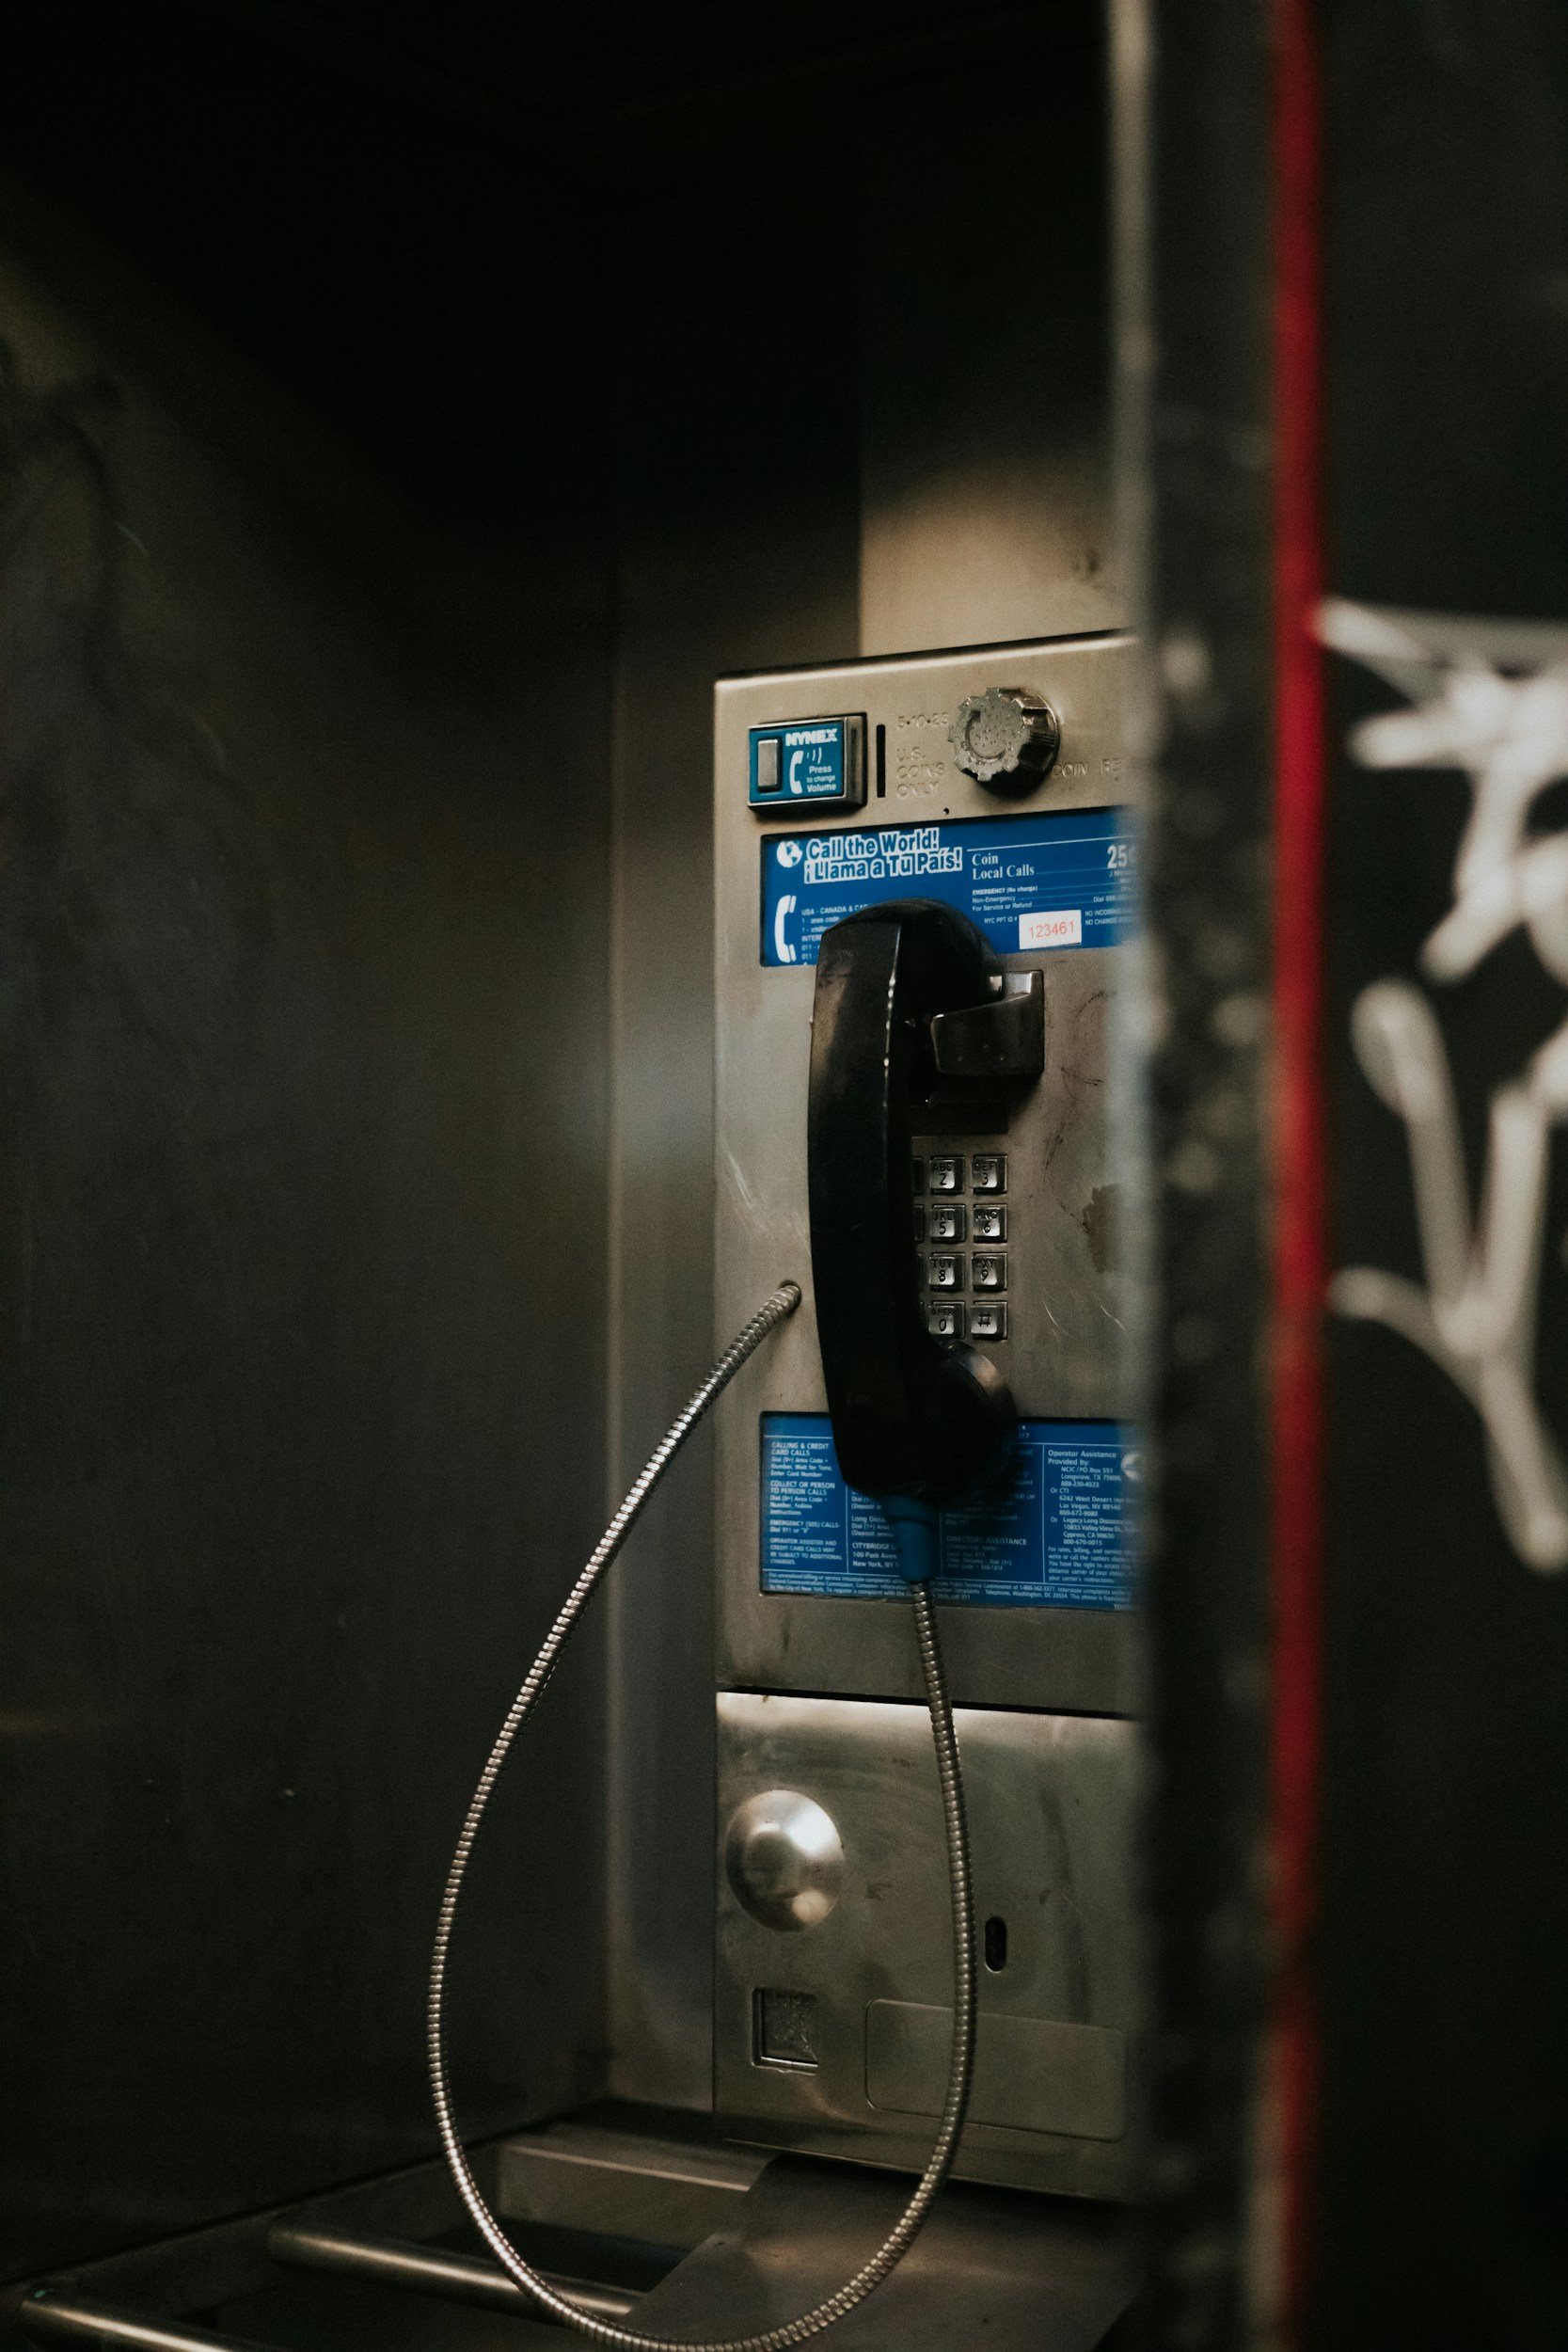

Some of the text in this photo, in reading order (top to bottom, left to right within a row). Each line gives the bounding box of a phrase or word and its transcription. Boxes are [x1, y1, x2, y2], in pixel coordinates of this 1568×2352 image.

[785, 728, 837, 746] NYNEX
[809, 766, 832, 774] Press
[897, 762, 944, 781] COINS
[1052, 762, 1088, 778] COIN
[815, 774, 836, 783] change
[807, 783, 836, 793] Volume
[897, 781, 939, 799] ONLY
[806, 827, 940, 861] Call the World!
[870, 858, 885, 879] a
[886, 851, 913, 877] Tu
[915, 847, 963, 875] País!
[972, 853, 998, 866] Coin
[973, 866, 1003, 880] Local
[1006, 864, 1035, 877] Calls
[972, 896, 1015, 904] Non-Emergency
[1029, 921, 1074, 938] 123461
[933, 1162, 952, 1172] ABC
[974, 1162, 995, 1171] DEF
[940, 1173, 946, 1186] 2
[982, 1173, 989, 1185] 3
[934, 1211, 952, 1221] JKL
[939, 1222, 946, 1234] 5
[984, 1221, 991, 1233] 6
[933, 1259, 952, 1269] TUV
[938, 1270, 946, 1282] 8
[982, 1270, 989, 1281] 9
[939, 1319, 946, 1331] 0
[978, 1313, 991, 1327] #
[1048, 1449, 1078, 1458] Operator
